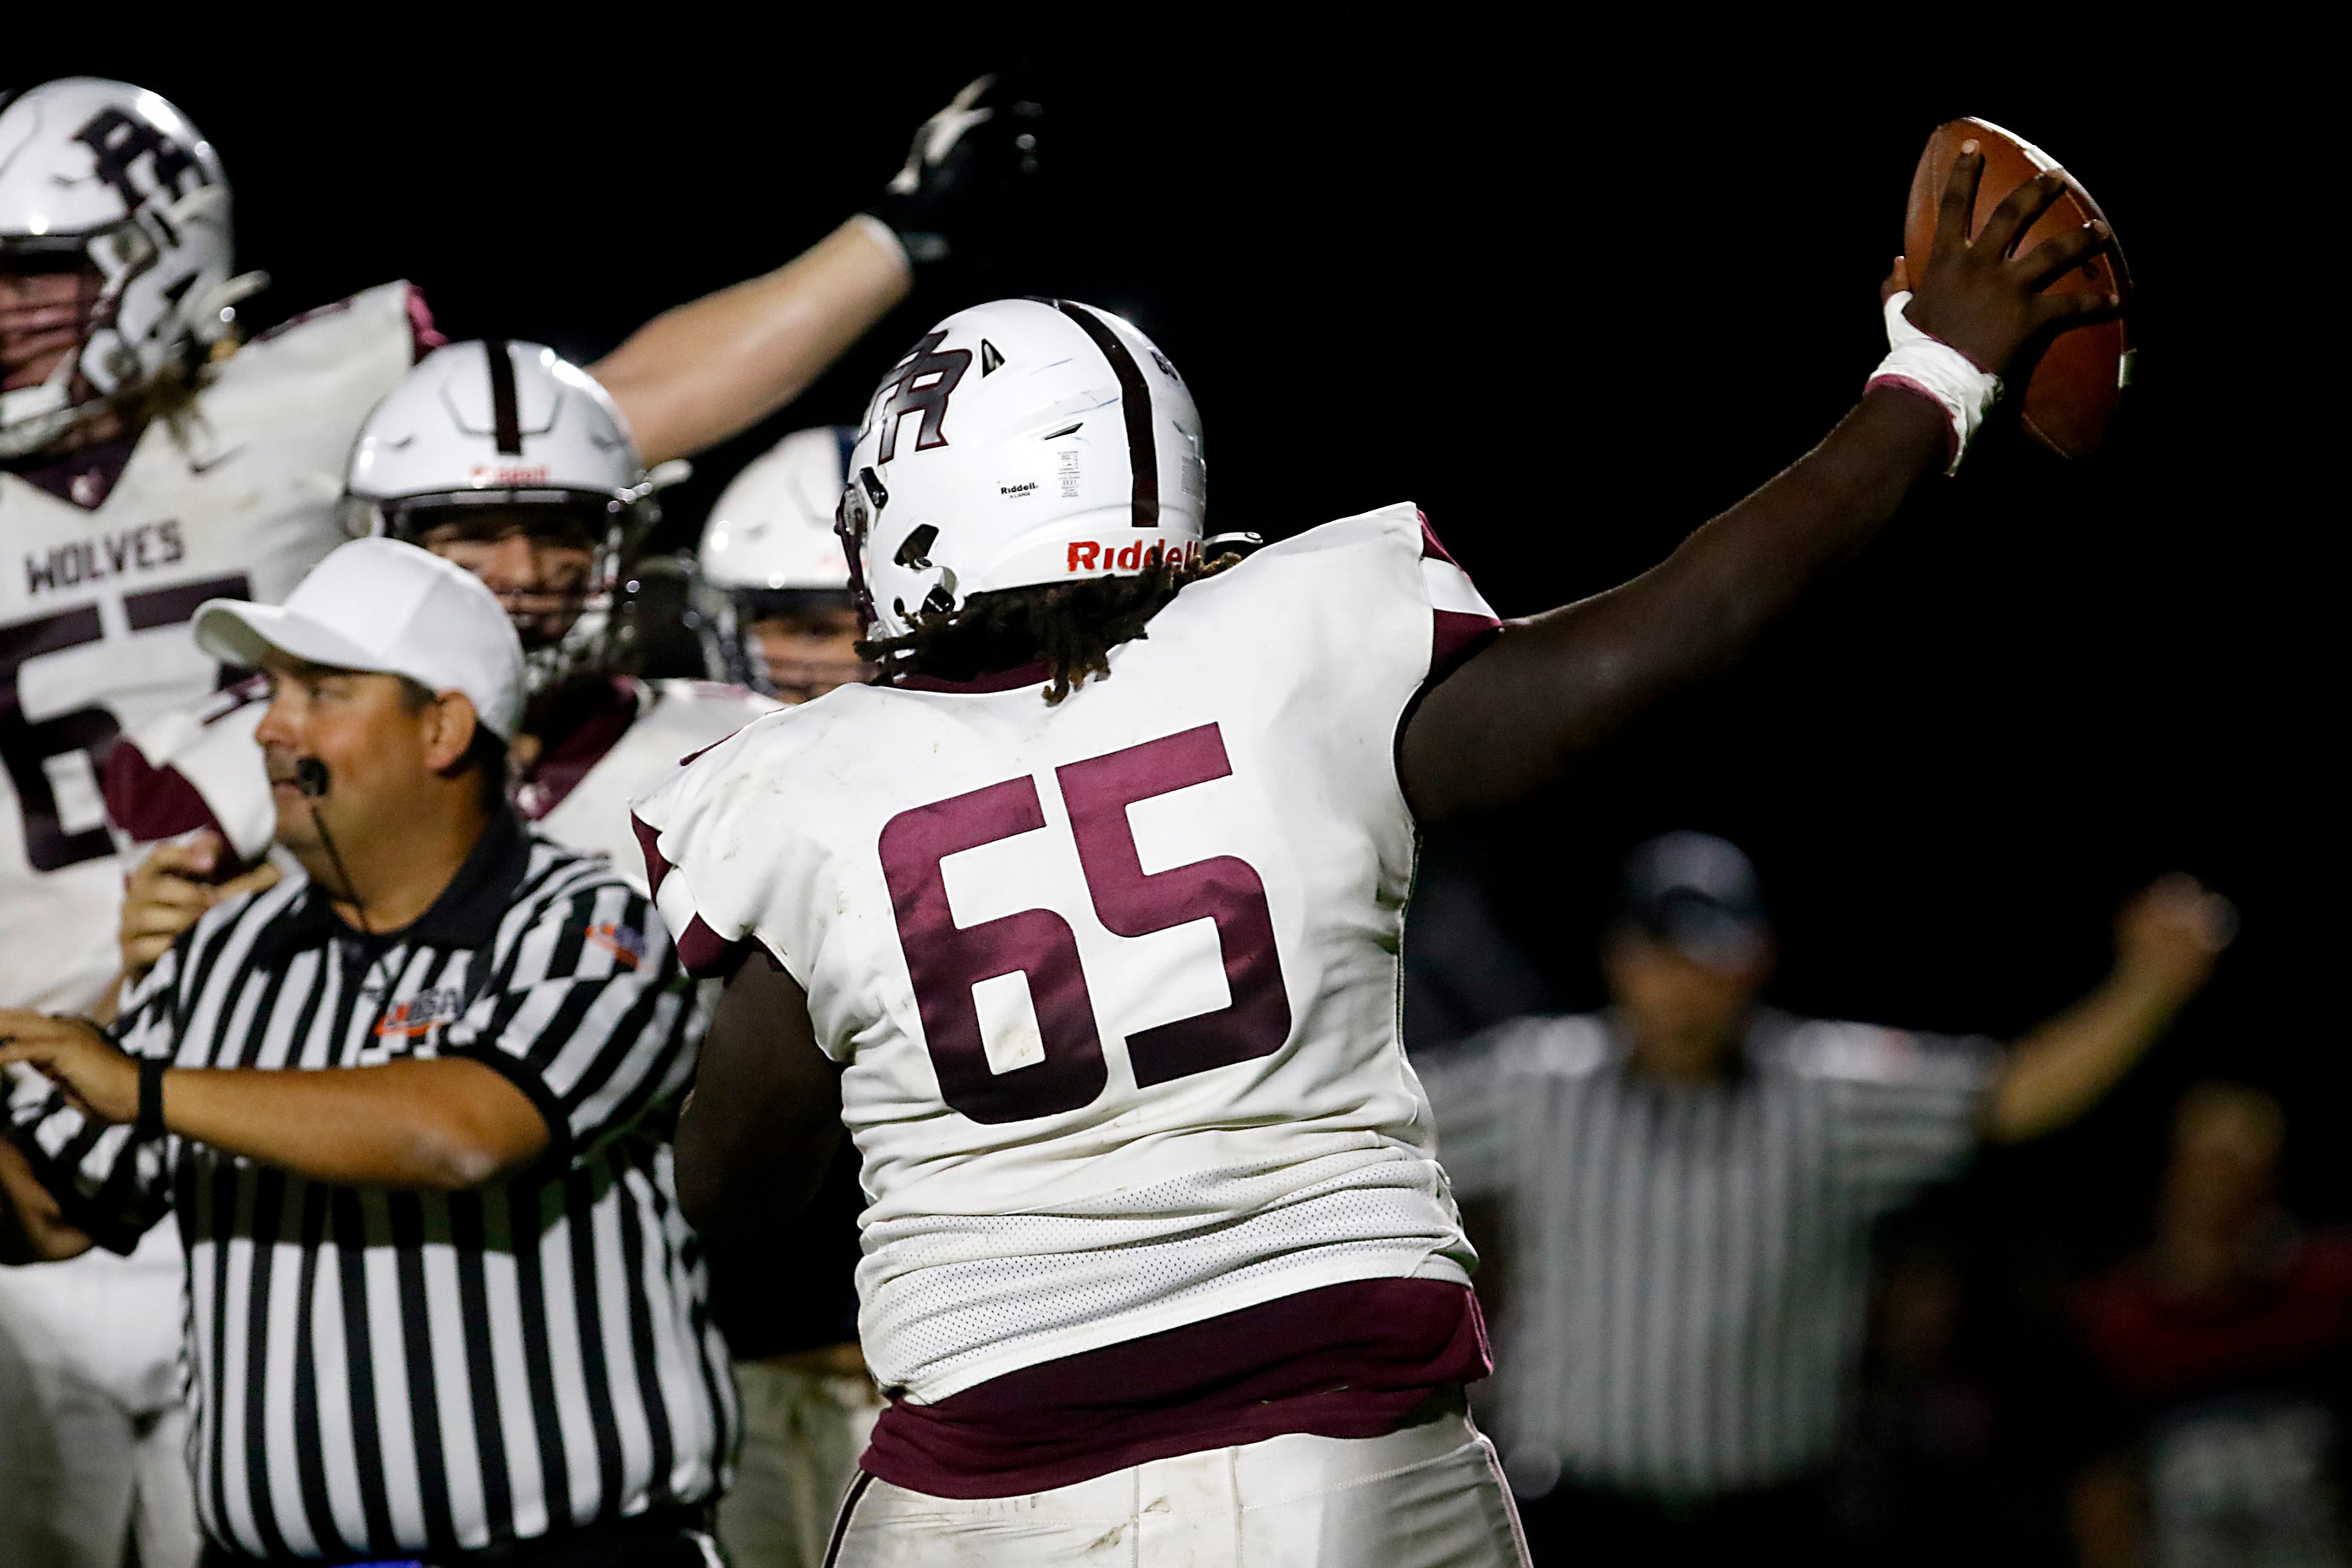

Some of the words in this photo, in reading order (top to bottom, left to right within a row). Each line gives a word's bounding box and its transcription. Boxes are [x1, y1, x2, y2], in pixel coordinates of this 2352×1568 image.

[1000, 482, 1036, 495] Riddell
[24, 518, 186, 595] WOLVES
[878, 721, 1292, 1125] 65
